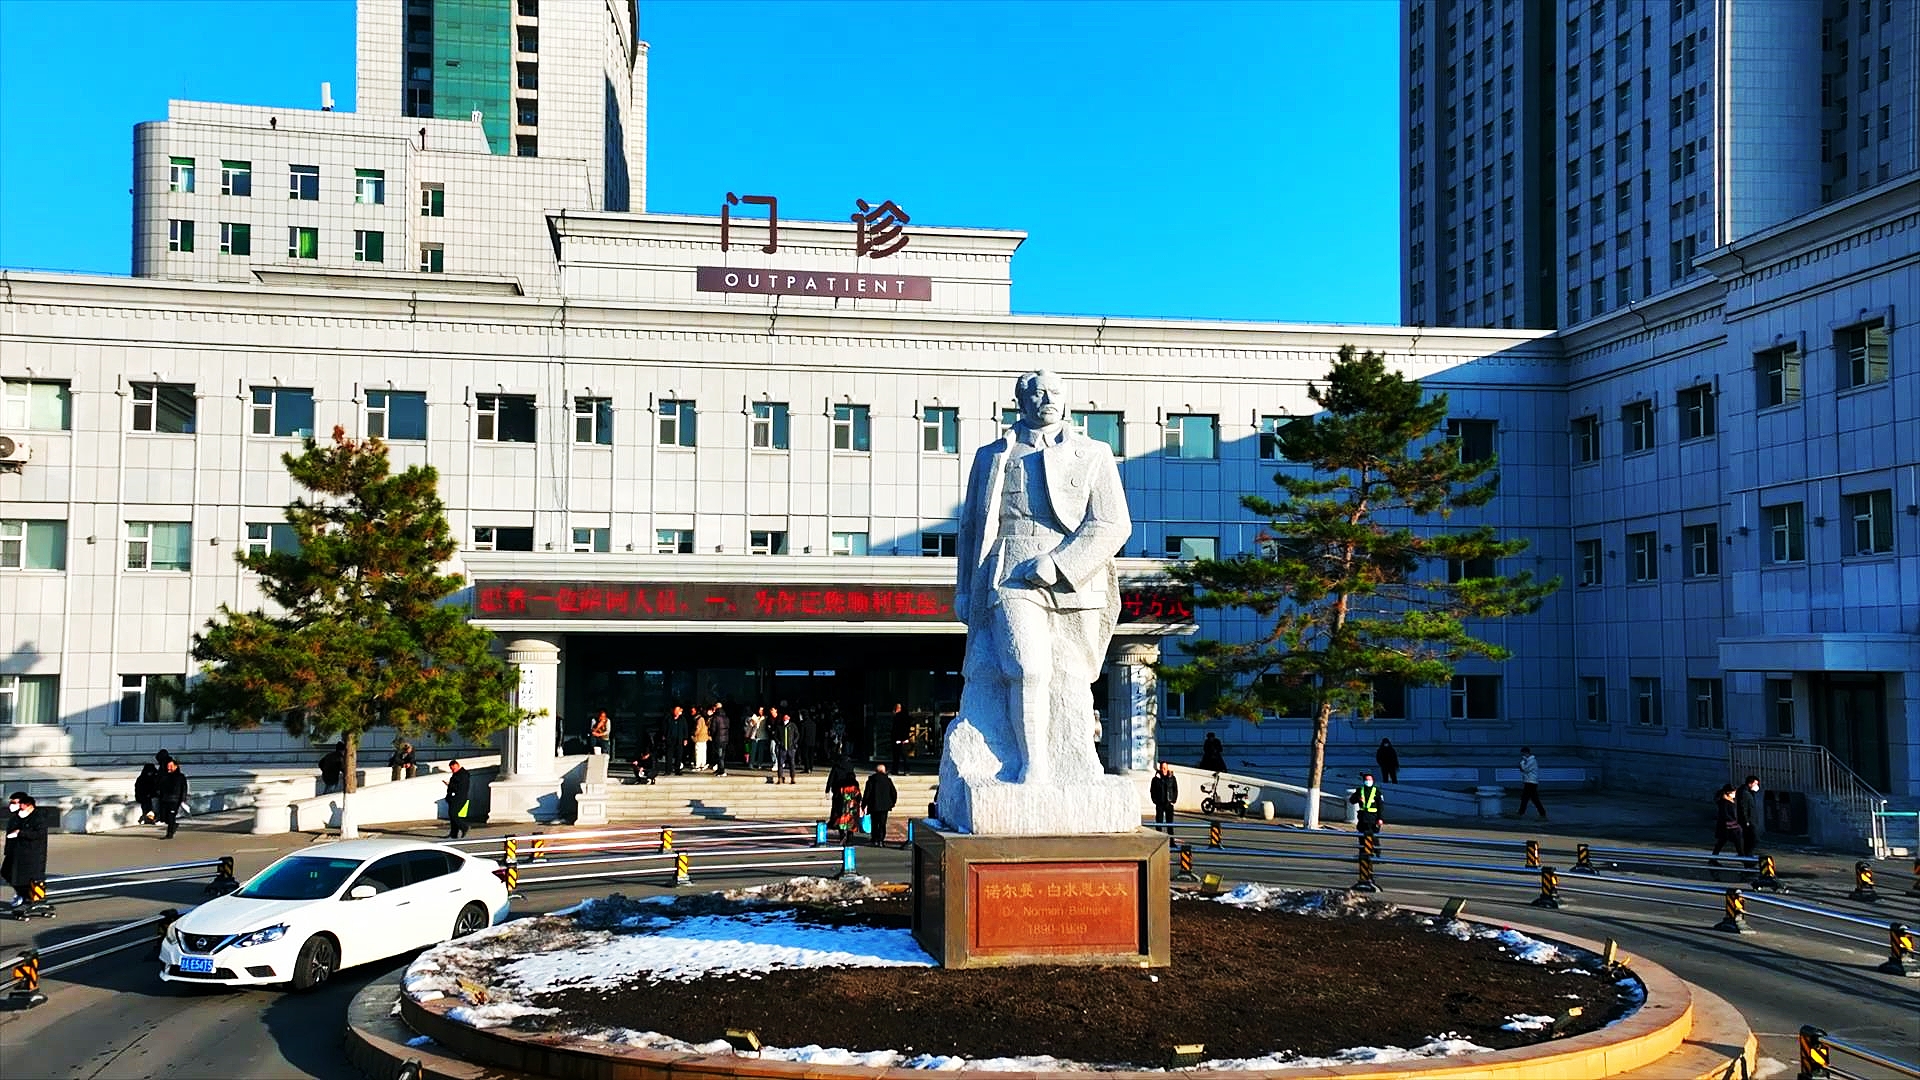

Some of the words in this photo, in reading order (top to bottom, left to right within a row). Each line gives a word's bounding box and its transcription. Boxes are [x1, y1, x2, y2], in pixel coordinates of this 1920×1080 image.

[721, 191, 911, 259] 门诊
[724, 273, 905, 295] OUTPATIENT
[1023, 905, 1064, 917] Norman
